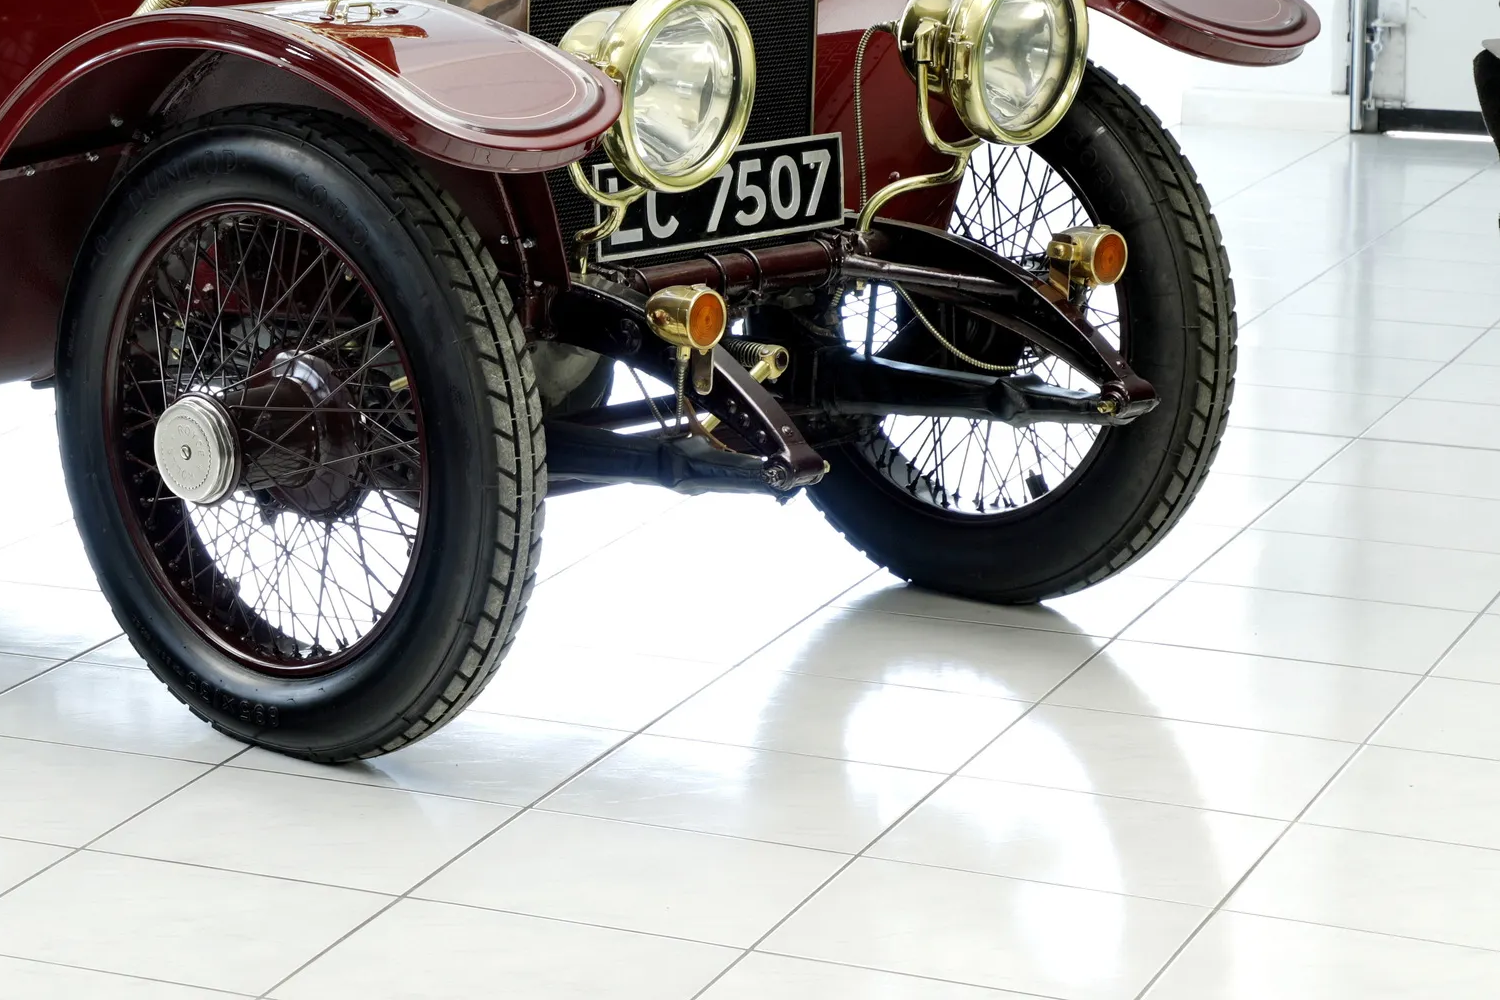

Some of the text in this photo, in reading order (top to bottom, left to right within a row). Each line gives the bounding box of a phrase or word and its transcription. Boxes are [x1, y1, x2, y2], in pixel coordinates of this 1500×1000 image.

[127, 149, 238, 214] DUNLOP
[292, 172, 370, 247] CORD
[706, 148, 832, 233] 7507
[177, 424, 205, 458] ROYCE
